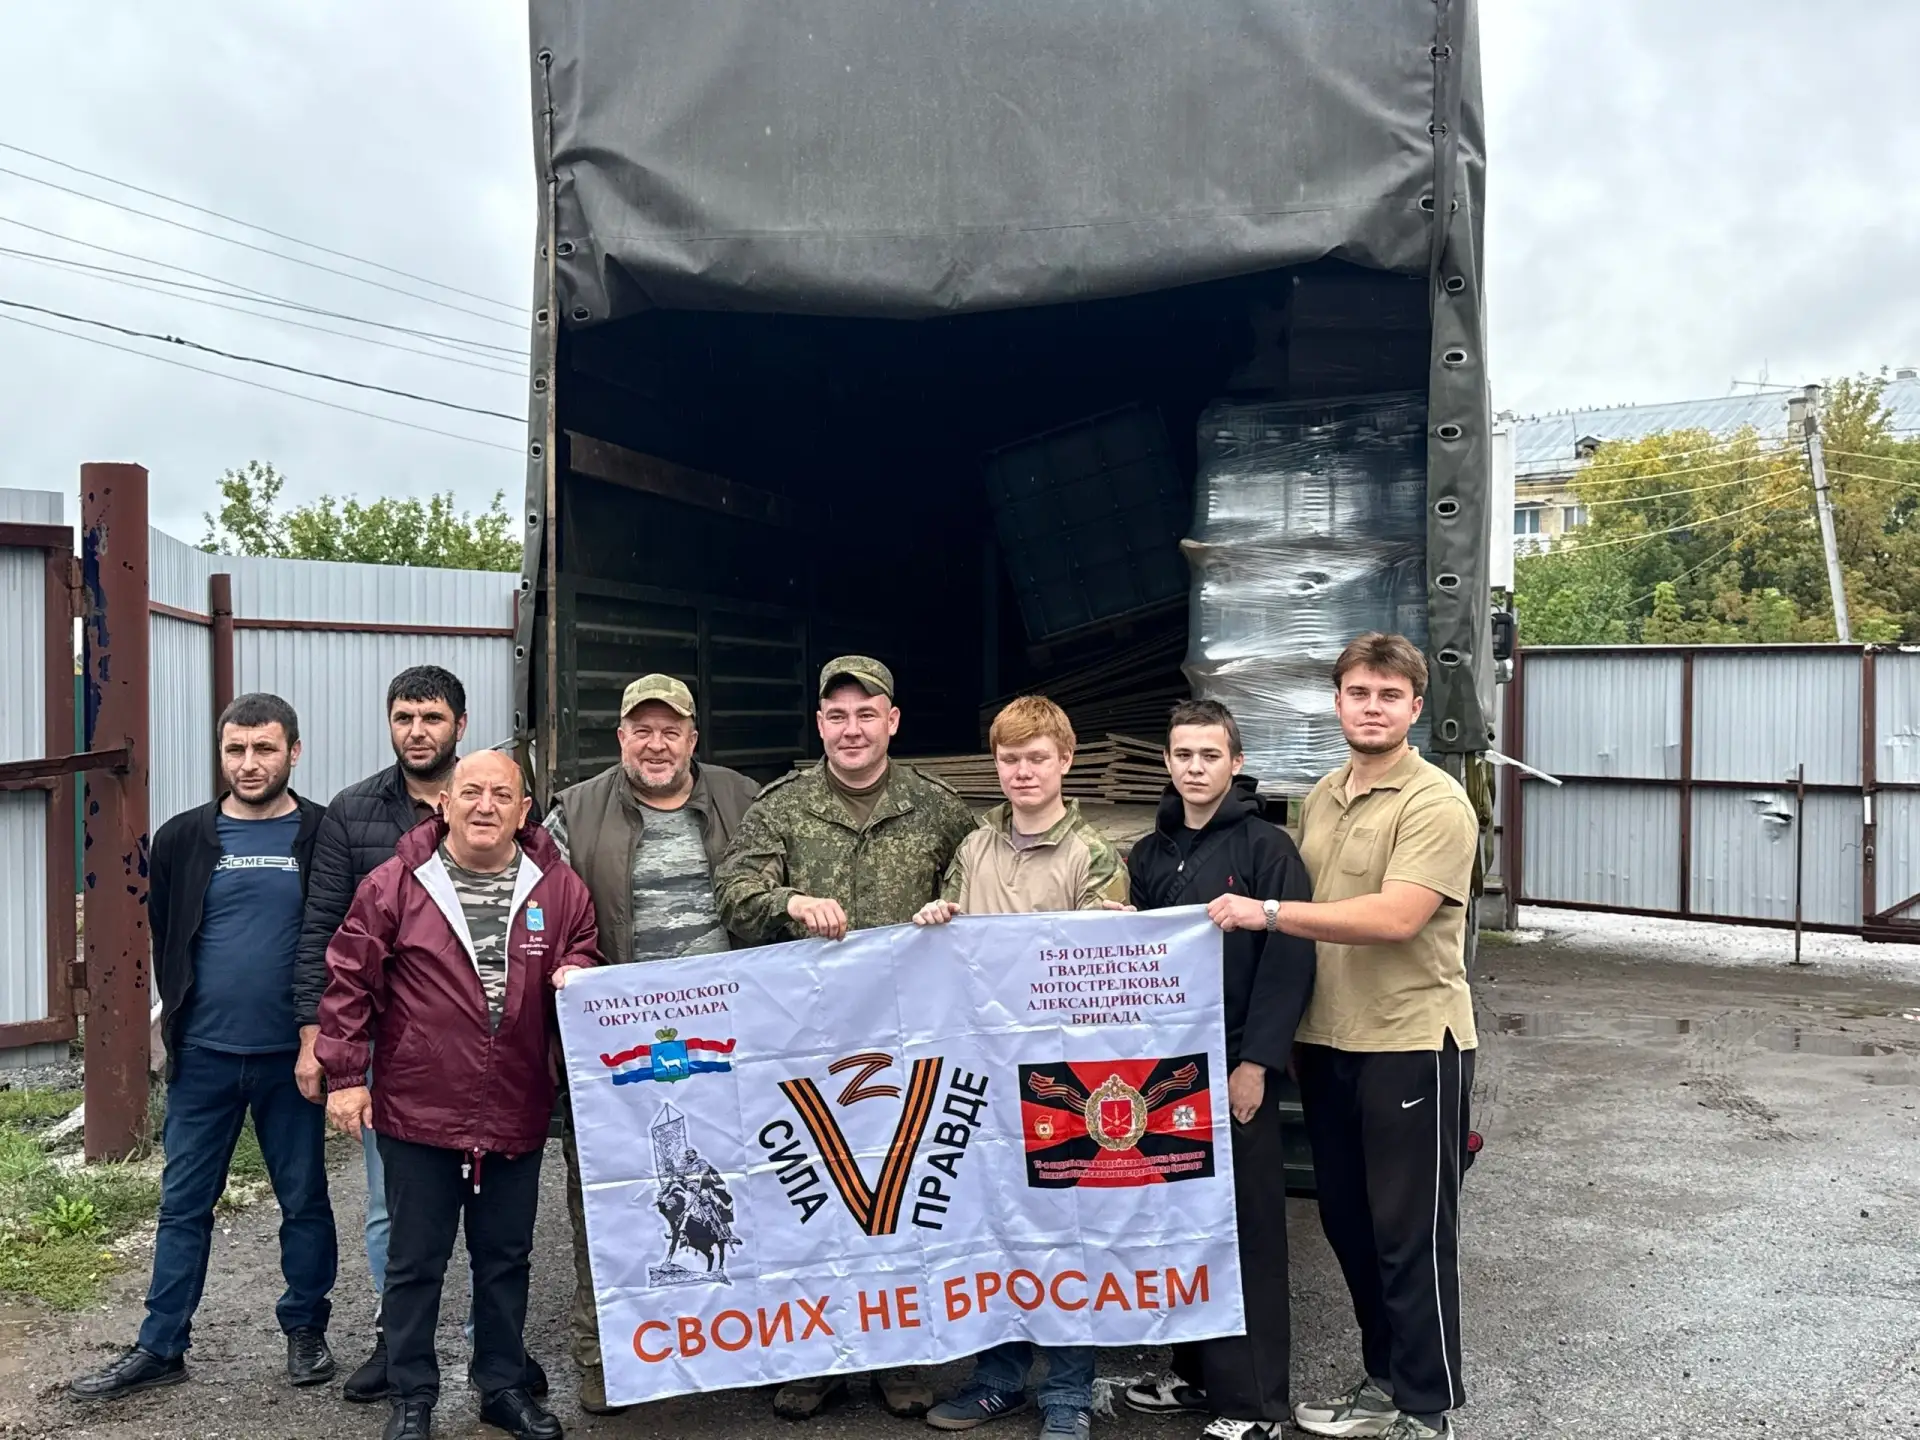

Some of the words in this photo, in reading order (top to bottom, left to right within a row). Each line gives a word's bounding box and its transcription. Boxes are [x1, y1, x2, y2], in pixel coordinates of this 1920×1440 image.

[1039, 949, 1068, 961] 15-Я
[1073, 943, 1167, 960] ОТДЕЛЬНАЯ
[1048, 960, 1159, 977] ГВАРДЕЙСКАЯ
[1030, 976, 1180, 994] МОТОСТРЕЛКОВАЯ
[583, 998, 630, 1013] ДУМА
[635, 982, 740, 1007] ГОРОДСКОГО
[1027, 992, 1186, 1011] АЛЕКСАНДРИЙСКАЯ
[599, 1011, 660, 1027] ОКРУГА
[665, 1001, 729, 1019] САМАРА
[1072, 1011, 1141, 1024] БРИГАДА
[758, 1120, 829, 1225] СИЛА
[911, 1067, 989, 1230] ПРАВДЕ
[633, 1295, 835, 1363] СВОИХ
[858, 1286, 921, 1332] НЕ
[944, 1264, 1209, 1322] БРОСАЕМ
